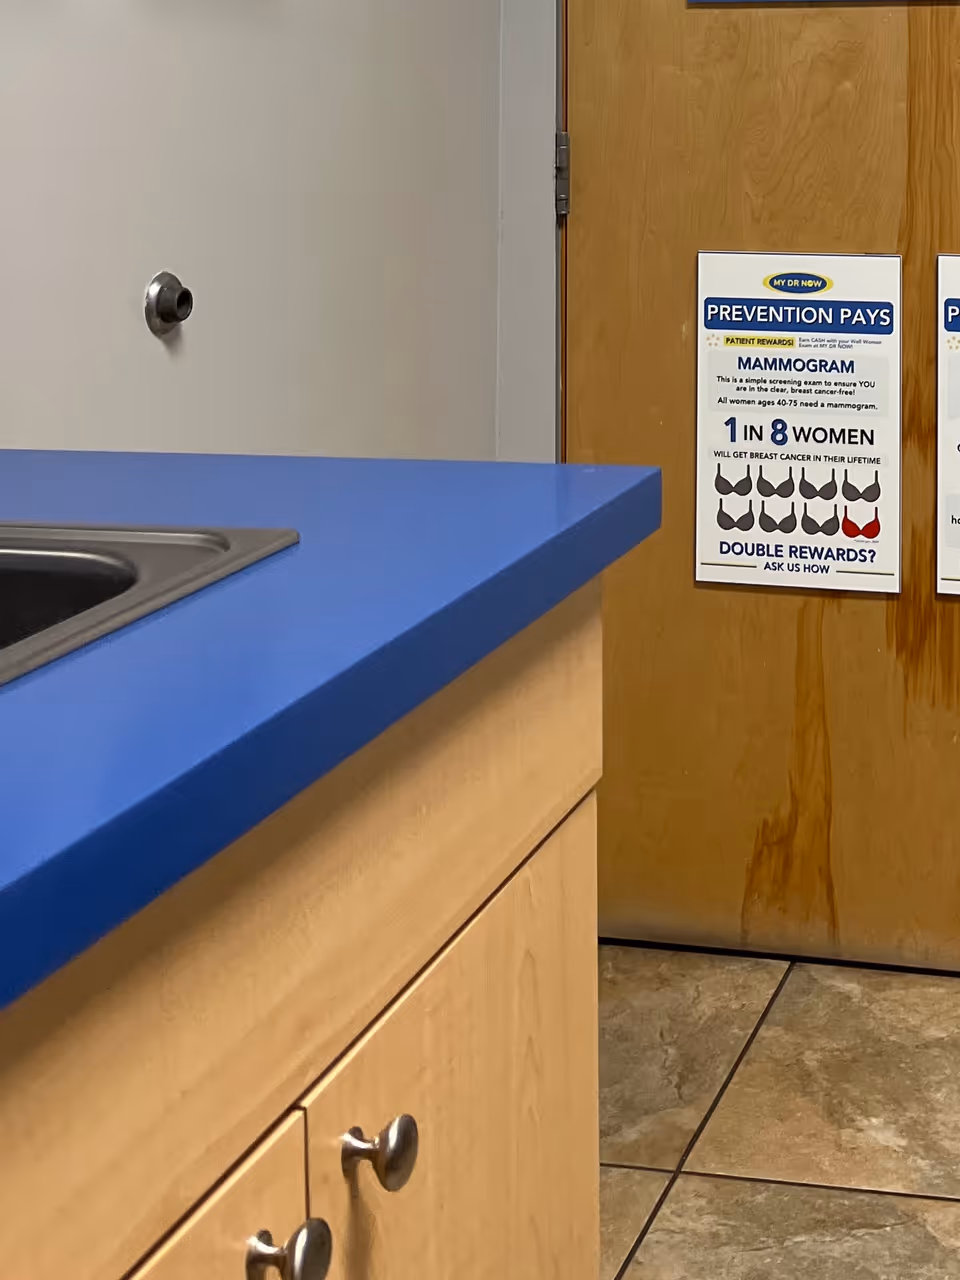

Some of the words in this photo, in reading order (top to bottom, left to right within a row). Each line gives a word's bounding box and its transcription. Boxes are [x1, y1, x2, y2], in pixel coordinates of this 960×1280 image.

[708, 305, 832, 324] PREVENTION
[840, 309, 891, 326] PAYS
[726, 337, 756, 345] PATIENT
[757, 338, 794, 346] REWARDS!
[738, 357, 855, 373] MAMMOGRAM
[770, 386, 788, 394] clear,
[827, 402, 878, 411] mammogram.
[724, 417, 736, 442] 1
[744, 425, 763, 441] IN
[770, 419, 788, 445] 8
[792, 426, 874, 445] WOMEN
[750, 452, 778, 460] BREAST
[780, 454, 811, 462] CANCER
[823, 455, 846, 463] THEIR
[719, 541, 783, 558] DOUBLE
[789, 545, 876, 562] REWARDS?
[764, 562, 784, 571] ASK
[787, 564, 800, 572] US
[803, 564, 830, 574] HOW
